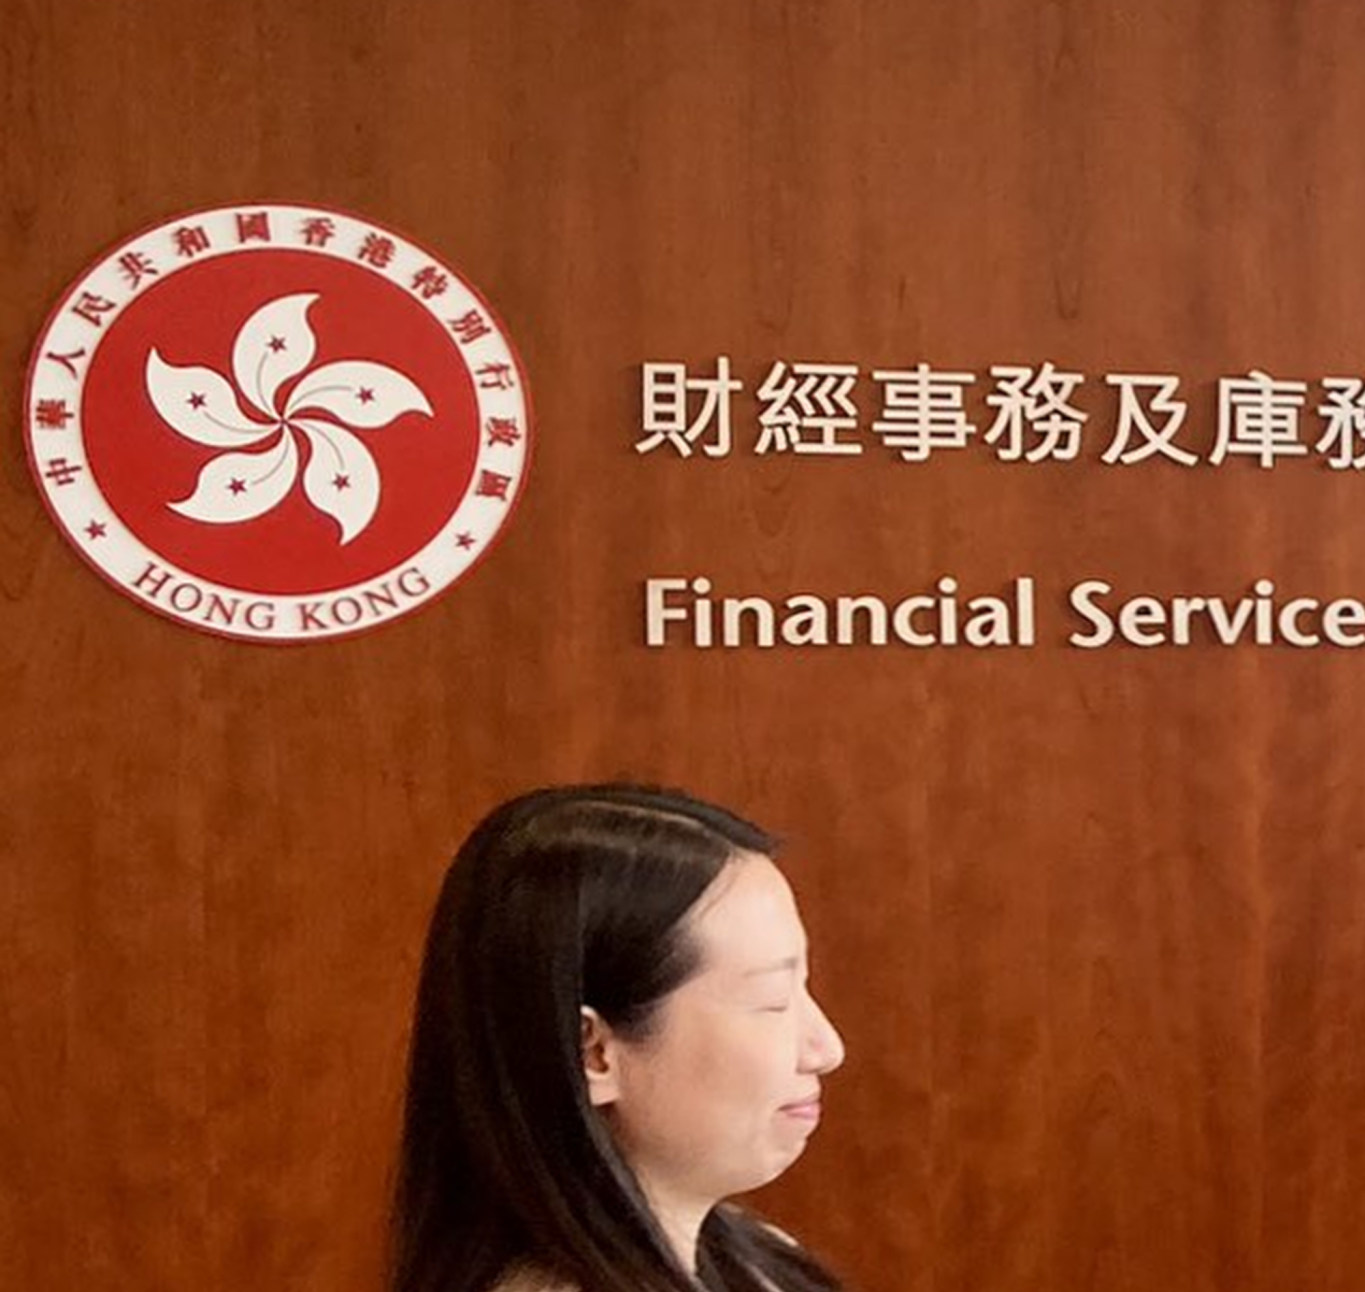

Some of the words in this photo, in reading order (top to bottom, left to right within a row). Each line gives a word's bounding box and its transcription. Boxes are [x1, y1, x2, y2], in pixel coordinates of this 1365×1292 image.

[131, 561, 277, 632] HONG
[298, 566, 432, 632] KONG
[645, 577, 1036, 648] Financial
